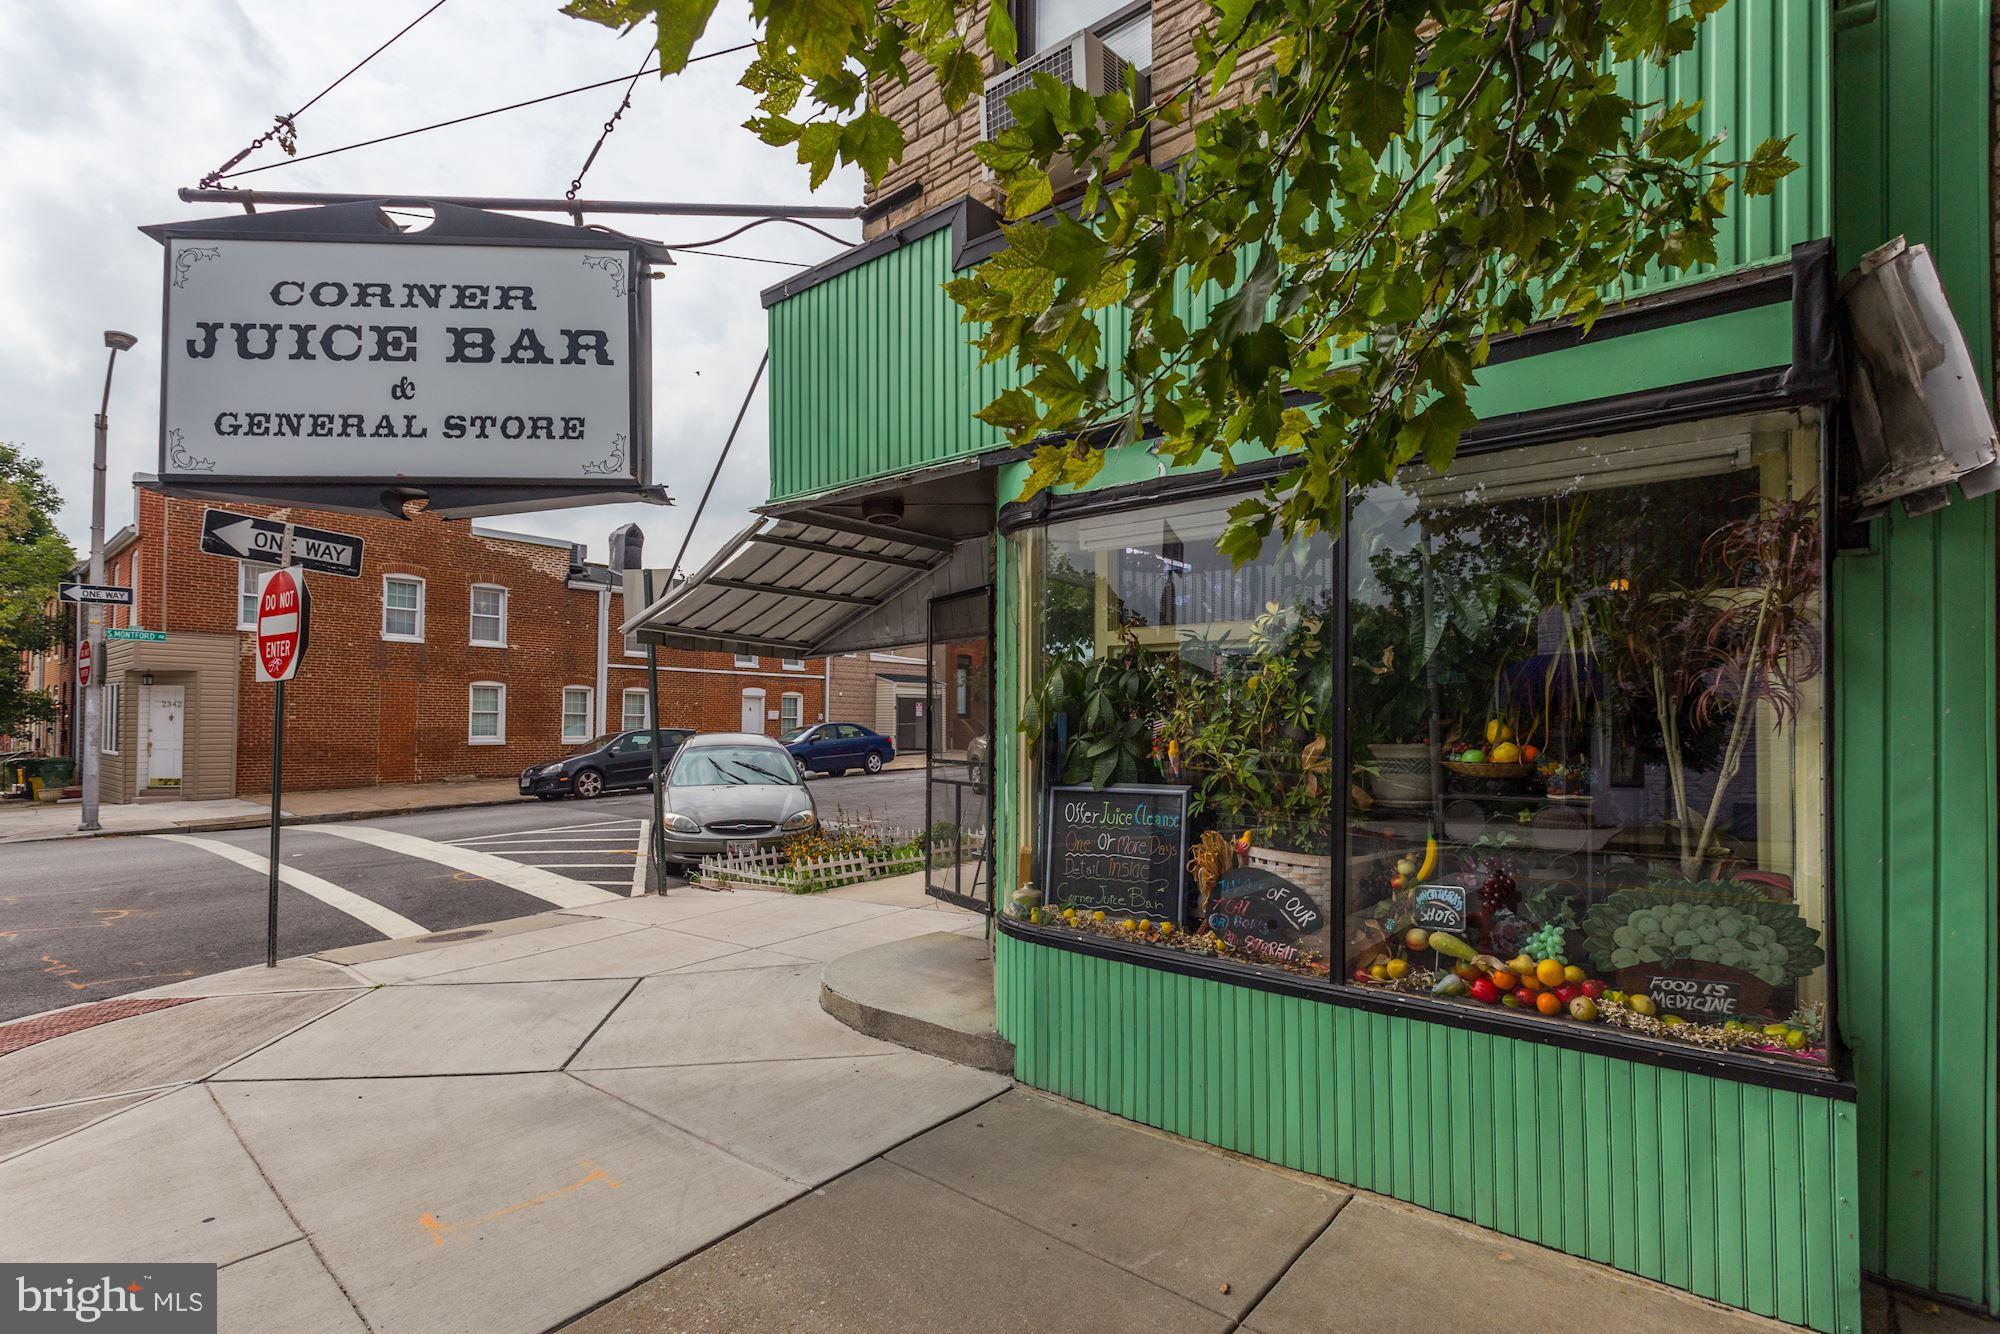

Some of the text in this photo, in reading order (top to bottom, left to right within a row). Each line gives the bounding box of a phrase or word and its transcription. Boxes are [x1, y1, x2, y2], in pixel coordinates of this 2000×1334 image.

[269, 280, 537, 311] CORNER
[186, 322, 615, 366] JUICE BAR
[391, 376, 415, 401] &
[214, 412, 586, 441] GENERAL STORE
[306, 541, 346, 562] WAY
[82, 590, 125, 600] ONE WAY
[265, 590, 295, 611] DO NOT
[107, 629, 113, 638] S
[114, 631, 156, 640] MONTFORD
[266, 639, 290, 658] ENTER
[1065, 802, 1100, 824] Offer
[1100, 801, 1133, 826] Juice
[1065, 830, 1091, 852] One
[1117, 835, 1147, 855] More
[1148, 835, 1178, 858] Days
[1064, 858, 1100, 877] Detail
[1057, 882, 1164, 910] Corner Juice Bar
[1266, 887, 1317, 927] OF OUR
[1210, 915, 1227, 929] OR
[1420, 907, 1456, 926] SHOTS
[1649, 976, 1730, 997] FOOD IS
[1651, 990, 1737, 1015] MEDICINE
